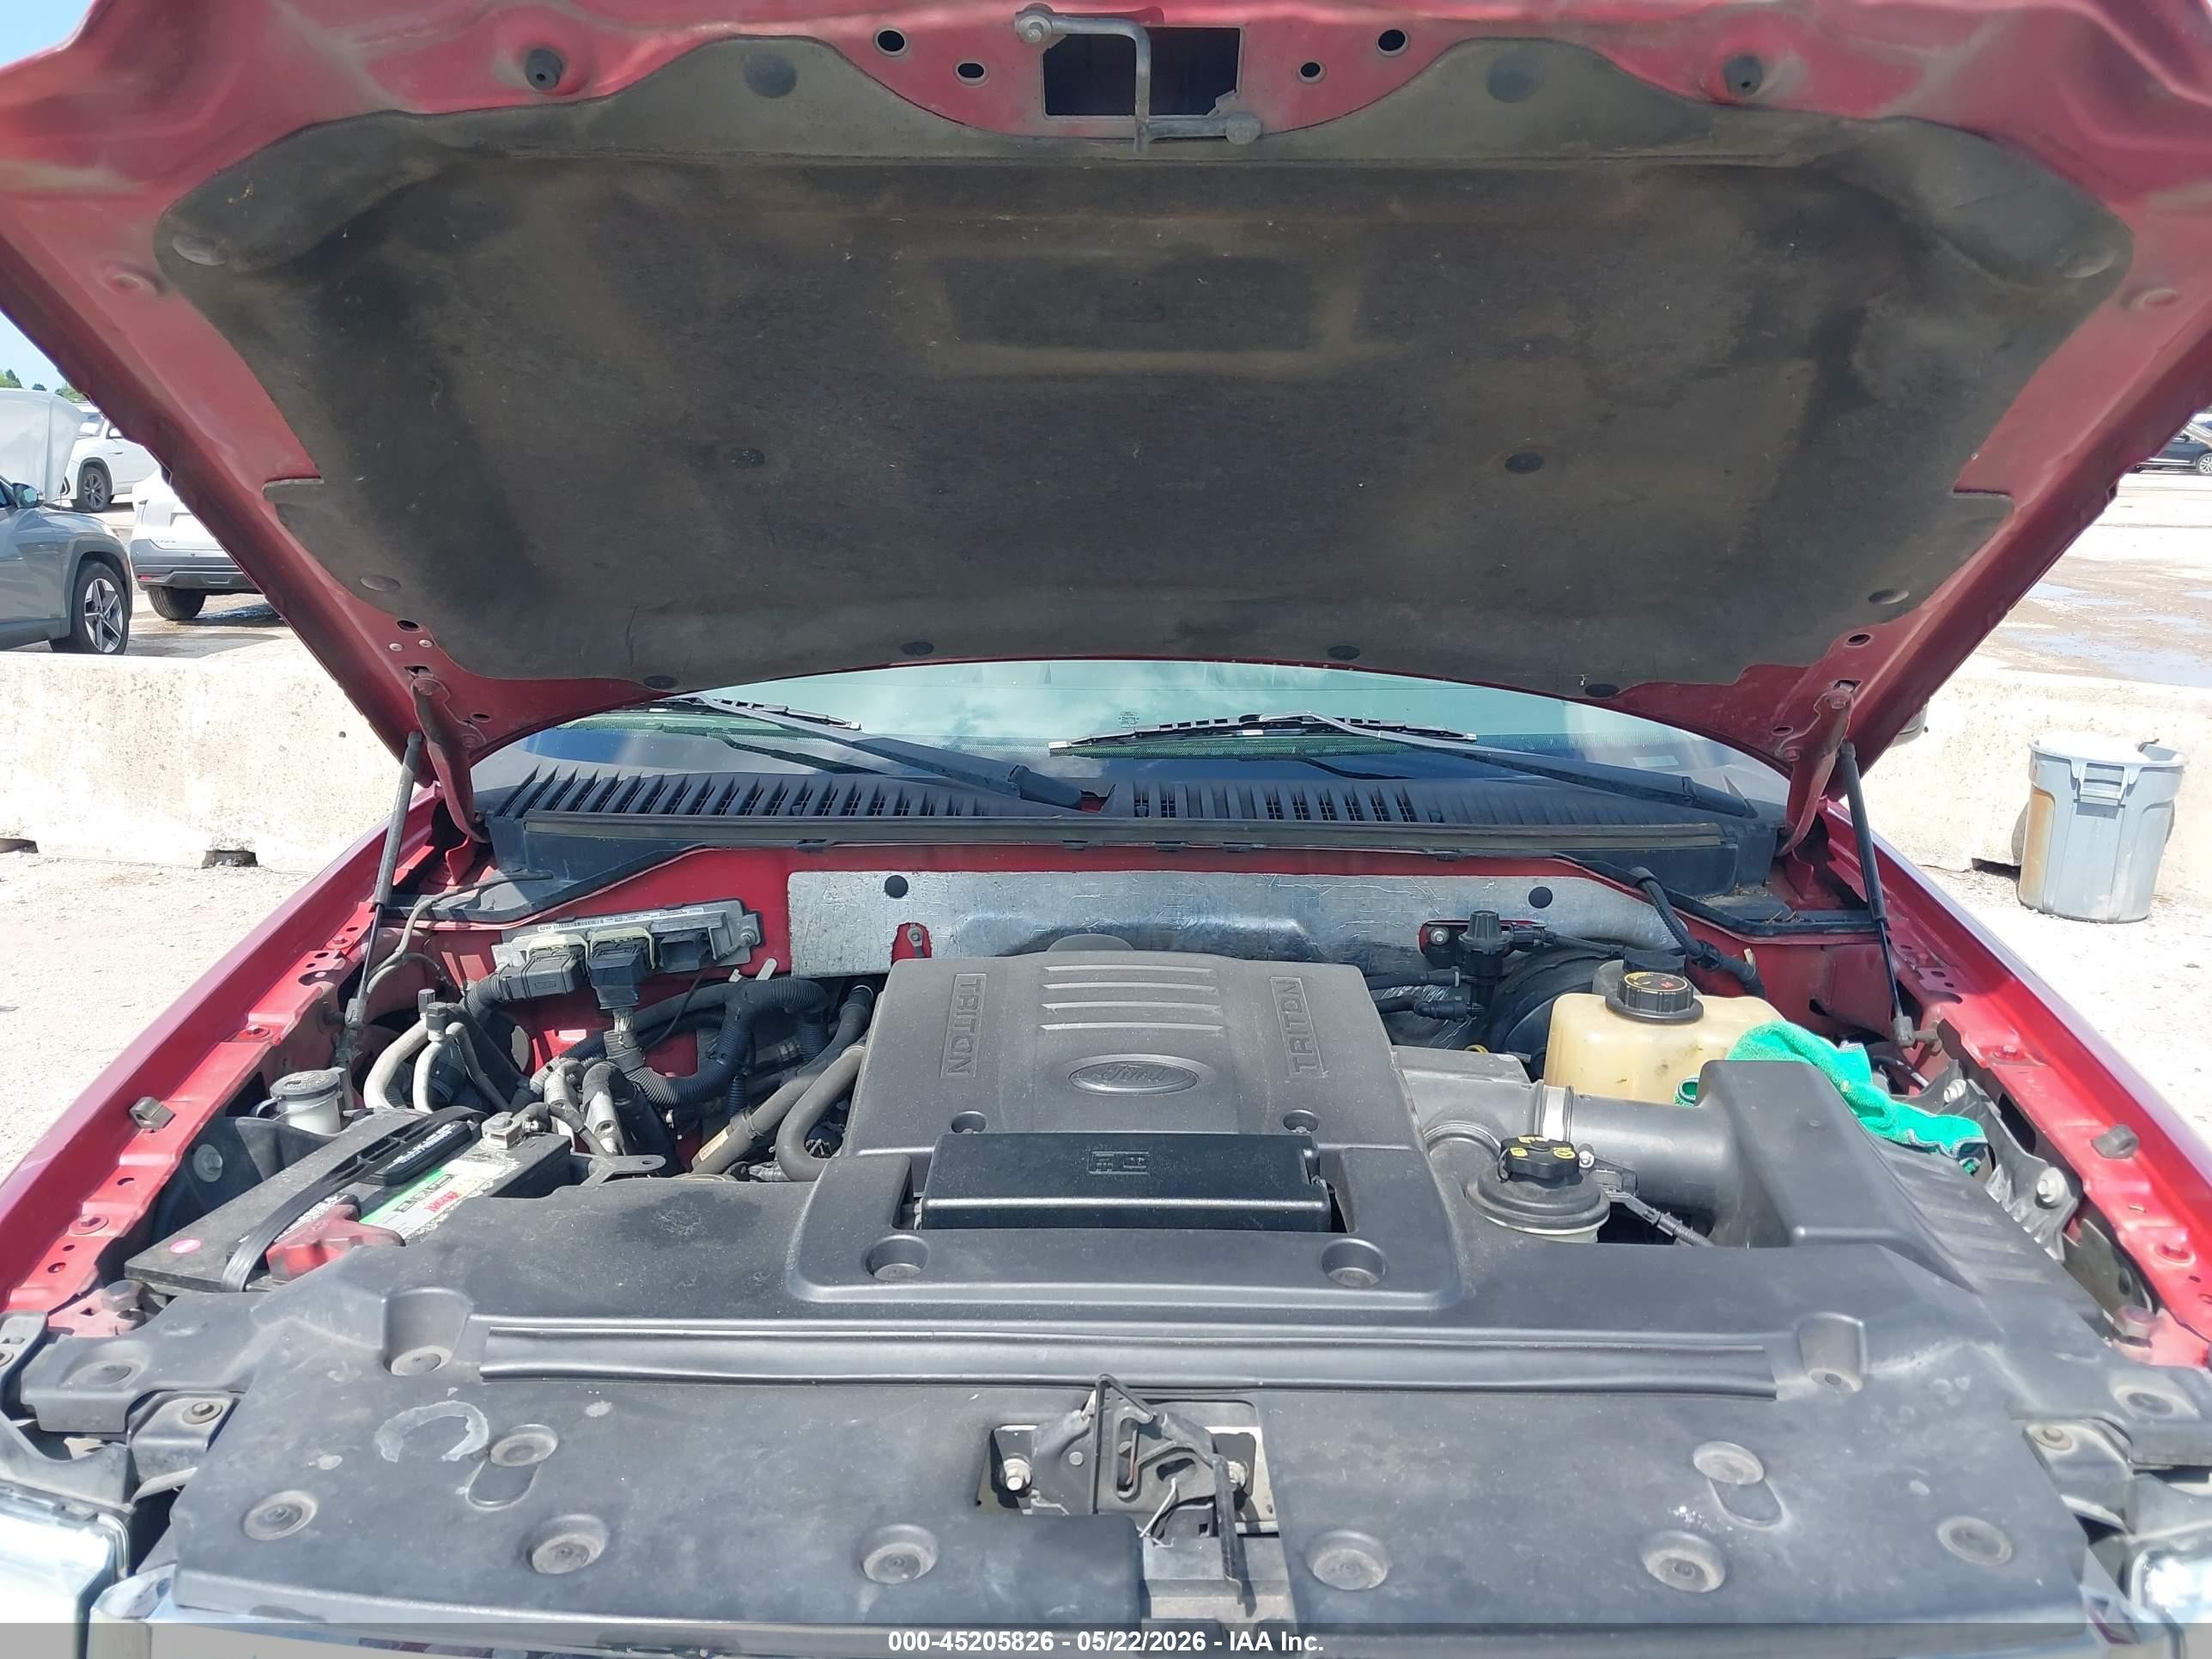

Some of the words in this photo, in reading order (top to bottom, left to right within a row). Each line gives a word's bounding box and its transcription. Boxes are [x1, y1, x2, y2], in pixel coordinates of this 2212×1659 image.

[946, 978, 981, 1075] TRITON
[1100, 1063, 1169, 1082] Ford
[1274, 981, 1317, 1074] TRITON
